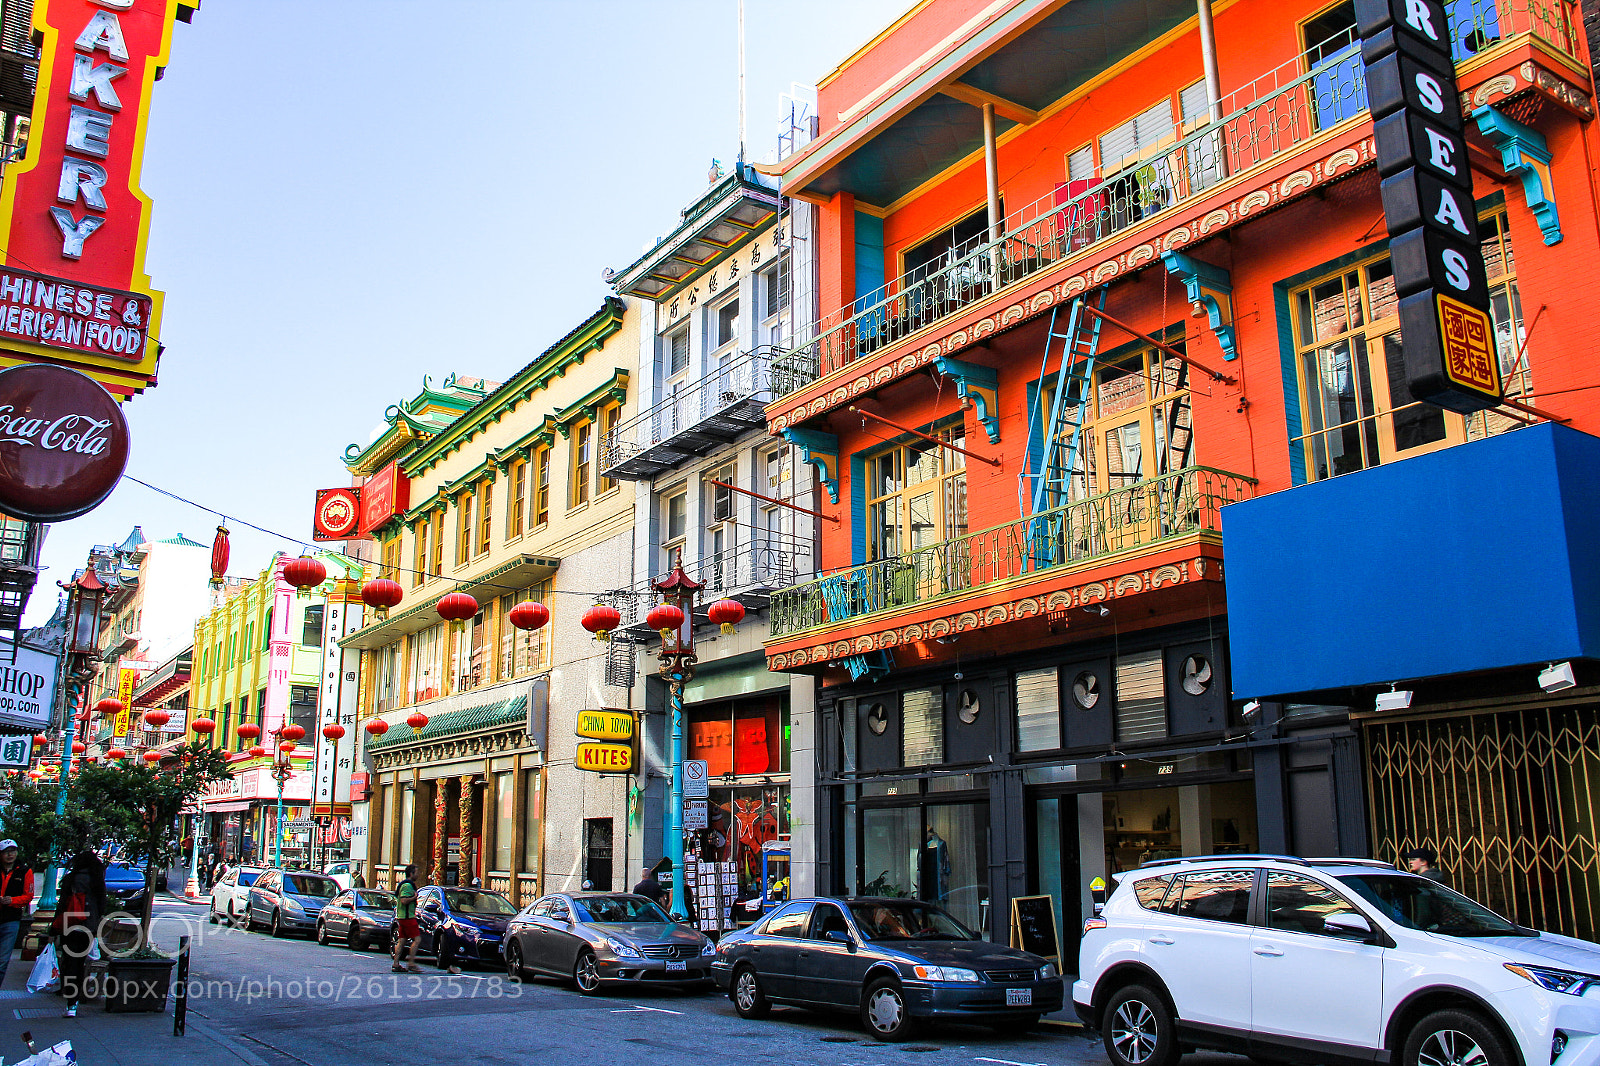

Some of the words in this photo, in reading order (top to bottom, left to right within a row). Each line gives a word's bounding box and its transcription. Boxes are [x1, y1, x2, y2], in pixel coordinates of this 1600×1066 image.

[1405, 0, 1438, 41] R
[49, 0, 136, 260] AKERY
[1415, 72, 1470, 291] SEAS
[0, 275, 114, 320] HINESE
[122, 299, 141, 326] &
[0, 304, 83, 345] ERICAN
[84, 320, 142, 354] FOOD
[0, 405, 113, 455] oca-Cola
[329, 609, 338, 658] Bank
[0, 666, 45, 699] HOP
[328, 671, 334, 693] of
[0, 697, 40, 714] op.com
[584, 715, 605, 732] CHINA
[611, 717, 631, 734] TOWN
[584, 749, 628, 765] KITES
